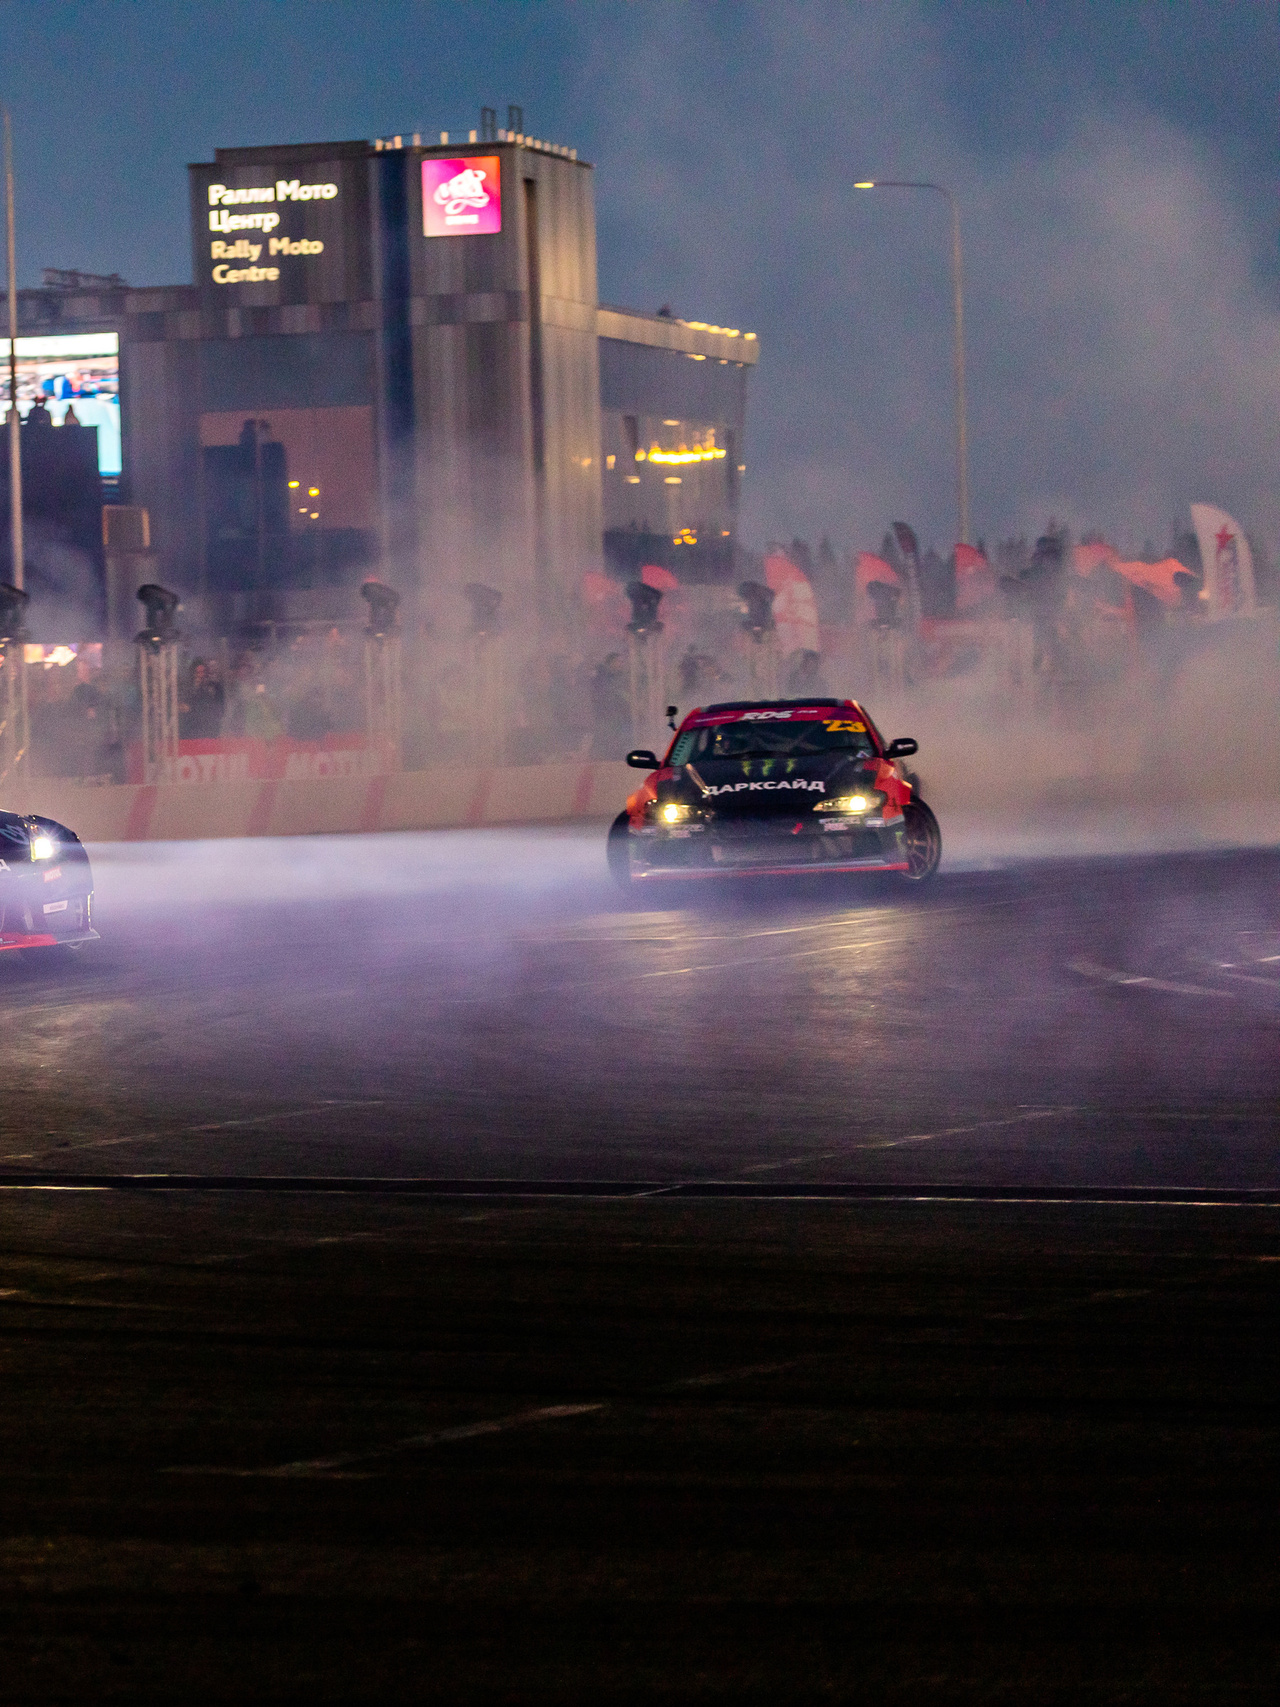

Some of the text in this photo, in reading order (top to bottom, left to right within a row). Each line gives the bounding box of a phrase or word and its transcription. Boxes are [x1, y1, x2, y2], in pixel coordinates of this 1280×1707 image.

[208, 179, 338, 206] Ралли Мото
[209, 209, 280, 233] Центр
[211, 237, 324, 262] Rally Moto
[212, 264, 280, 284] Centre
[822, 719, 867, 733] 23
[702, 779, 825, 798] ДАРКСАЙД
